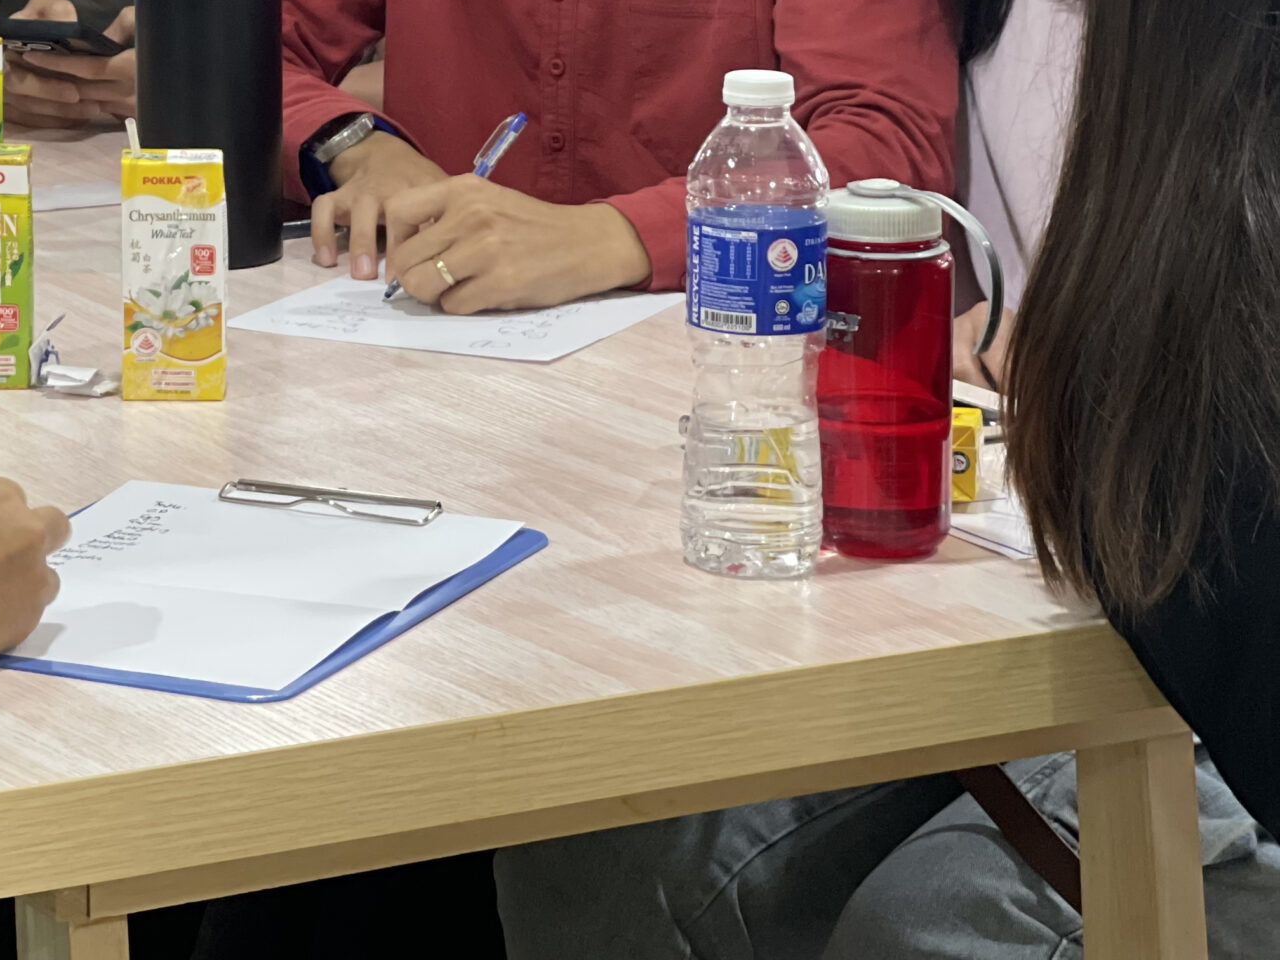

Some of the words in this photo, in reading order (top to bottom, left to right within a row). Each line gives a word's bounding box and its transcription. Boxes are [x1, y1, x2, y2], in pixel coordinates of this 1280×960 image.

[142, 176, 182, 185] POKKA
[128, 209, 216, 225] Chrysanthmum
[151, 228, 177, 239] White
[692, 225, 700, 250] ME
[692, 254, 700, 324] RECYCLE
